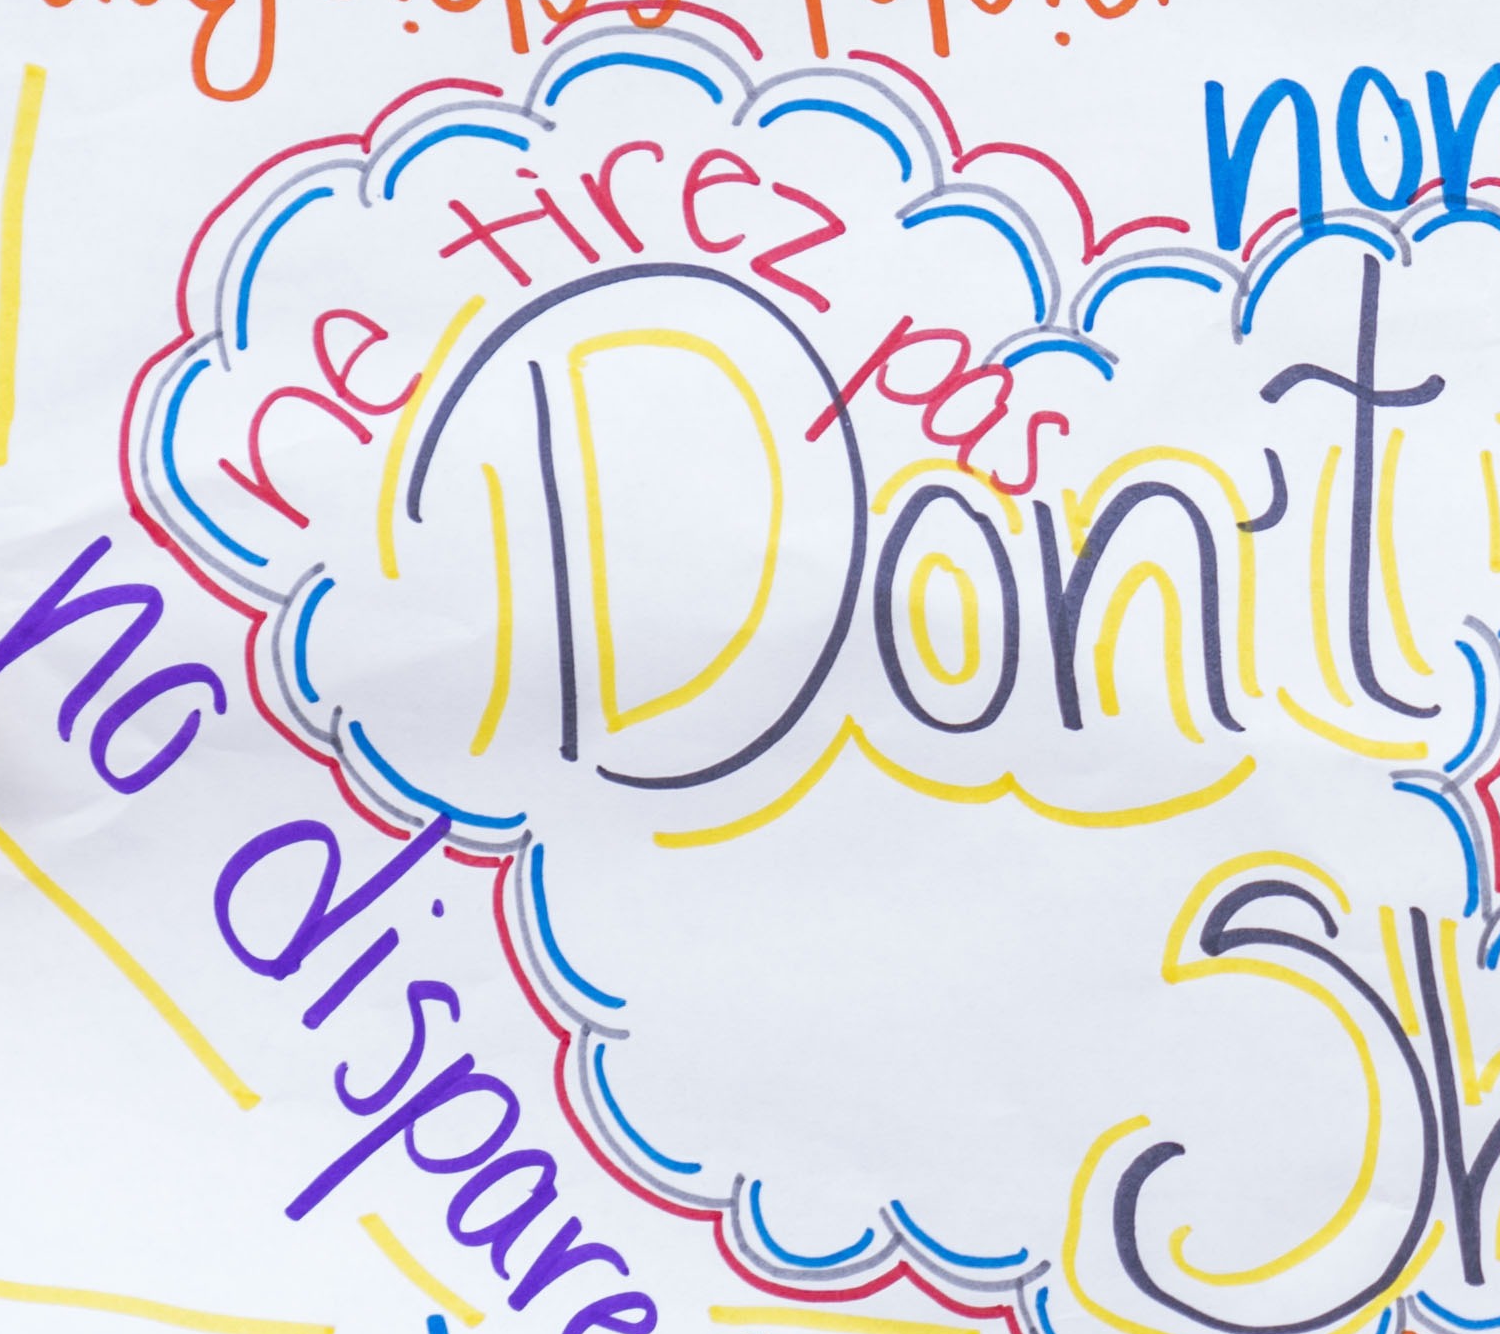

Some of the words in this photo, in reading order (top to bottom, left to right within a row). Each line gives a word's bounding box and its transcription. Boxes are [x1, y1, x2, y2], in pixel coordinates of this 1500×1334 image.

[219, 308, 423, 529] ne
[439, 140, 847, 313] tirez
[804, 315, 1070, 497] pas
[406, 253, 1442, 789] Don't
